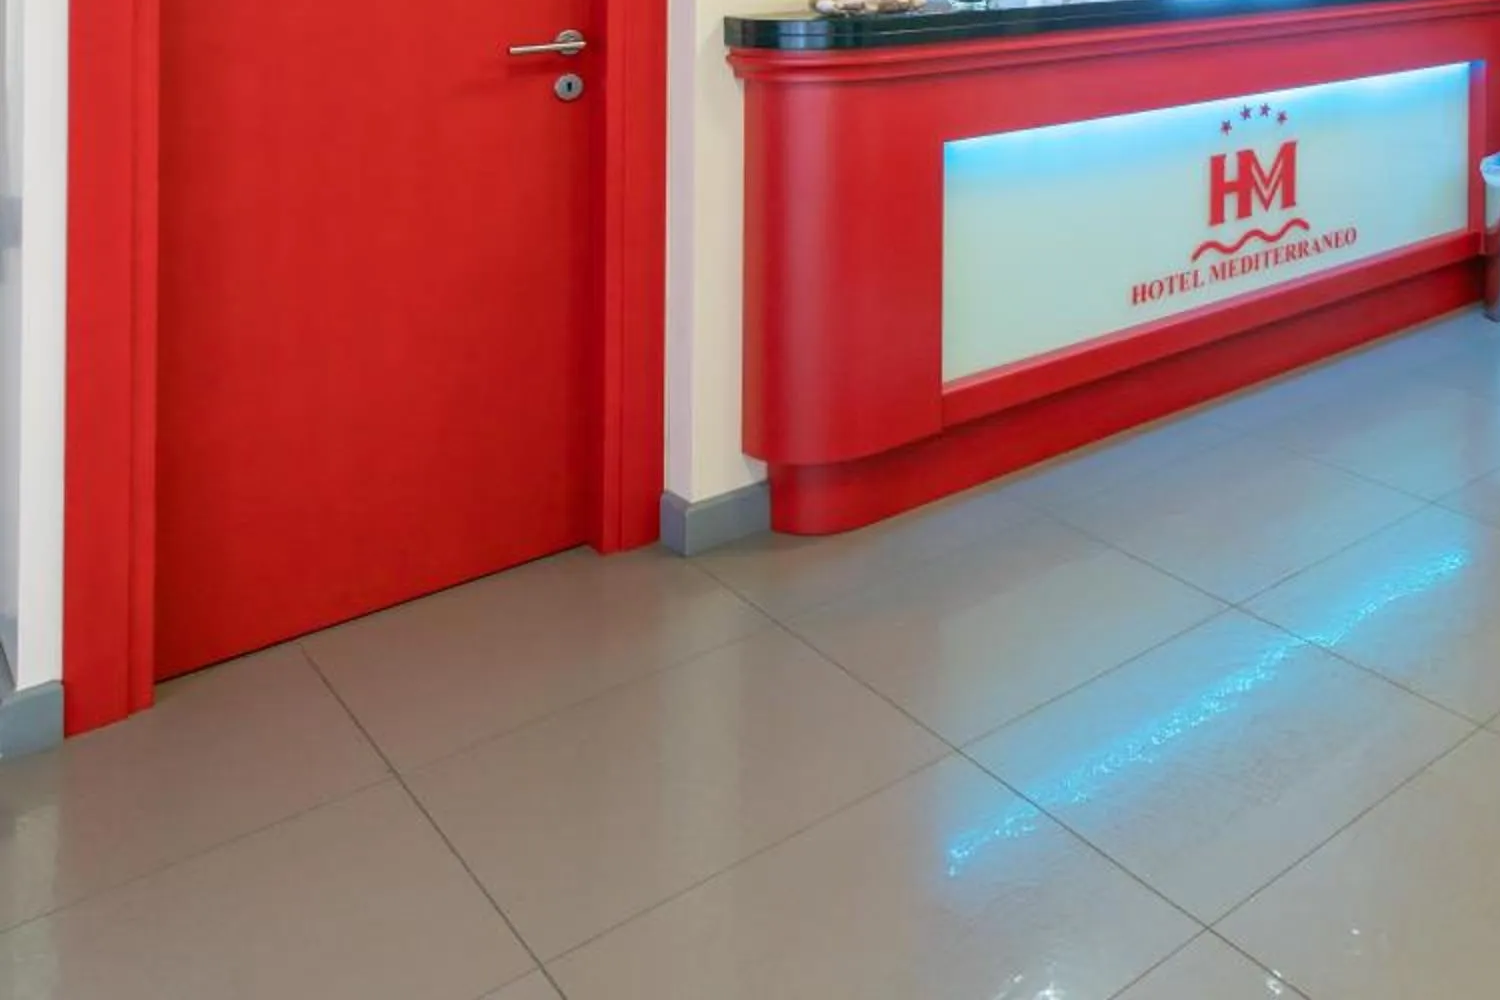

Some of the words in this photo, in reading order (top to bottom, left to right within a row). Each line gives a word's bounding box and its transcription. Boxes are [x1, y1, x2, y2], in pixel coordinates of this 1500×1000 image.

[1209, 140, 1296, 226] HM
[1131, 270, 1204, 305] HOTEL
[1209, 227, 1357, 283] MEDITERRANEO
